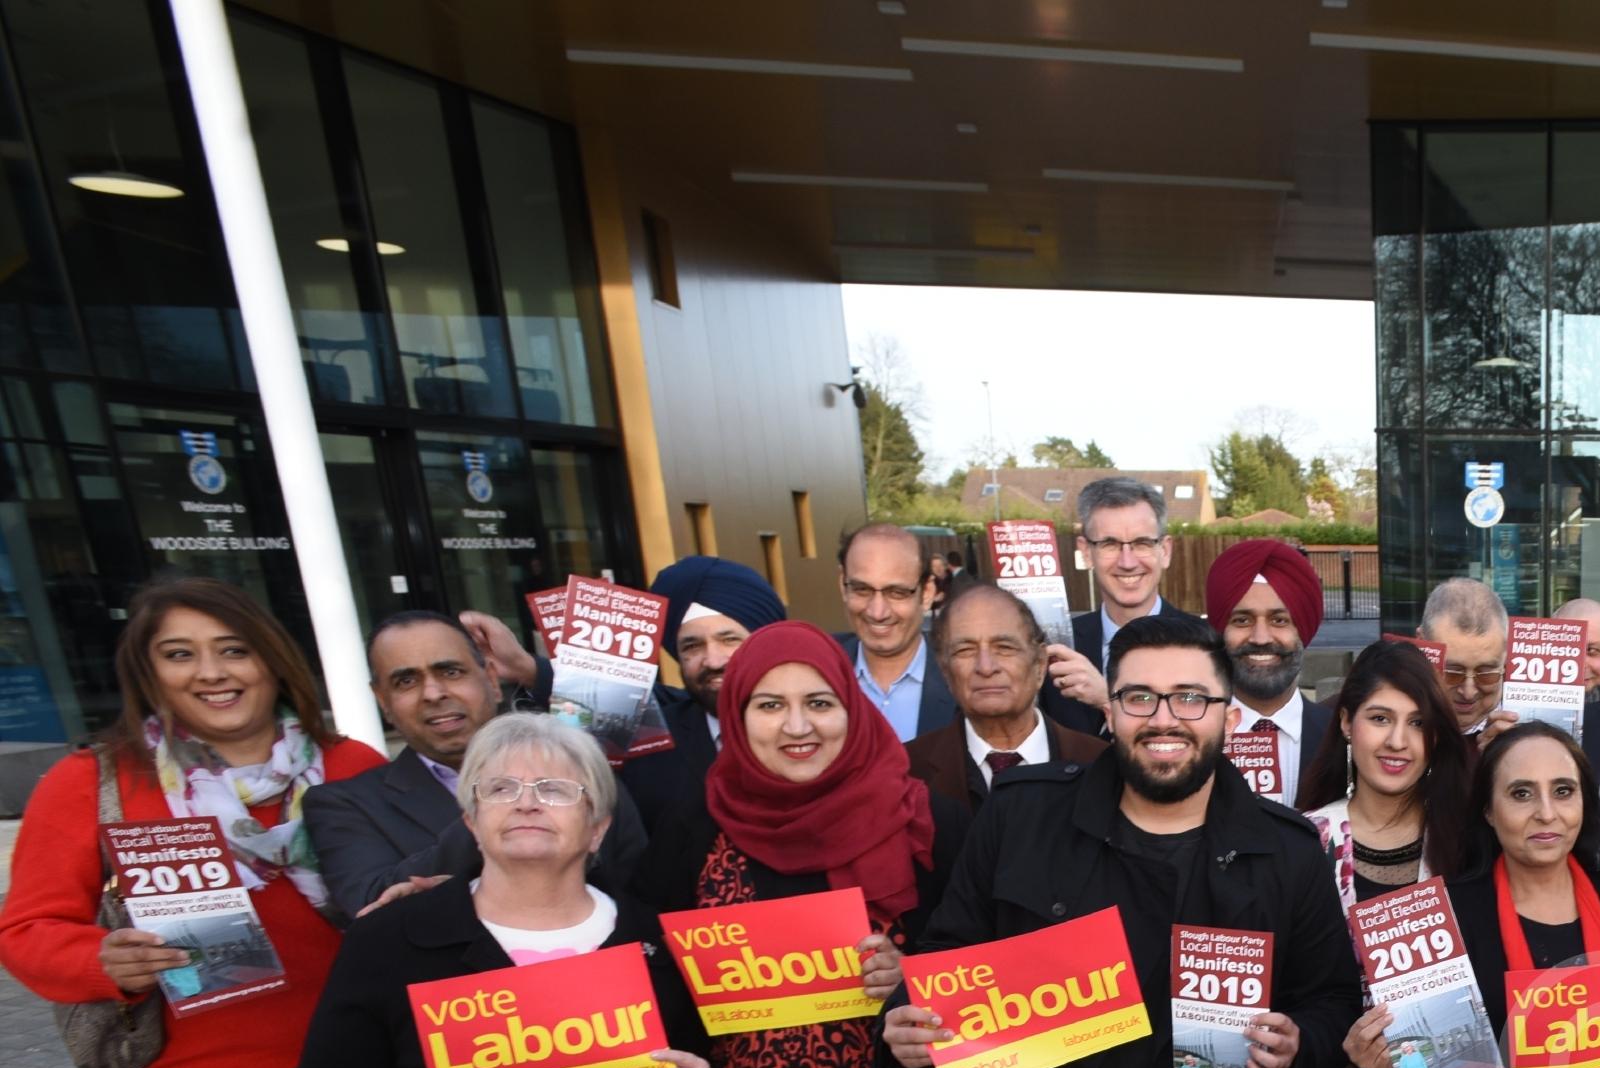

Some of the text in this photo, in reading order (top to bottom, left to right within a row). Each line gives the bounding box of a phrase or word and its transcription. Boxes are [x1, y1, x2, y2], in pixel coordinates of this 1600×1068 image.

[203, 519, 234, 533] THE
[149, 536, 290, 550] WOODSIDE BUILDING
[995, 542, 1053, 554] Manifesto
[998, 555, 1056, 577] 2019
[576, 590, 609, 606] Local
[611, 598, 659, 618] Election
[573, 604, 657, 634] Manifesto
[568, 620, 654, 660] 2019
[1513, 629, 1581, 642] Local Election
[1512, 642, 1580, 657] Manifesto
[560, 657, 604, 674] LABOUR
[607, 665, 650, 683] COUNCIL
[1510, 657, 1579, 683] 2019
[1506, 693, 1580, 705] LABOUR COUNCIL
[1230, 756, 1274, 767] ifesto
[1243, 769, 1276, 793] 19
[111, 831, 216, 848] Local Election
[117, 846, 222, 865] Manifesto
[124, 861, 231, 895] 2019
[134, 905, 186, 918] LABOUR
[188, 901, 246, 914] COUNCIL
[1355, 885, 1436, 917] Slough Labour Party
[1359, 897, 1440, 929] Local Election
[672, 921, 748, 950] vote
[1180, 930, 1265, 947] Slough Labour Party
[1363, 912, 1446, 947] Manifesto
[1180, 940, 1264, 957] Local Election
[1369, 928, 1454, 979] 2019
[682, 946, 863, 995] Labour
[1179, 953, 1264, 975] Manifesto
[911, 964, 995, 1000] vote
[1179, 971, 1262, 1005] 2019
[1422, 971, 1468, 991] COUNCIL
[421, 989, 518, 1026] vote
[1512, 982, 1587, 1009] vote
[1175, 1010, 1216, 1024] LABOUR
[1063, 1015, 1142, 1047] labour.org.uk
